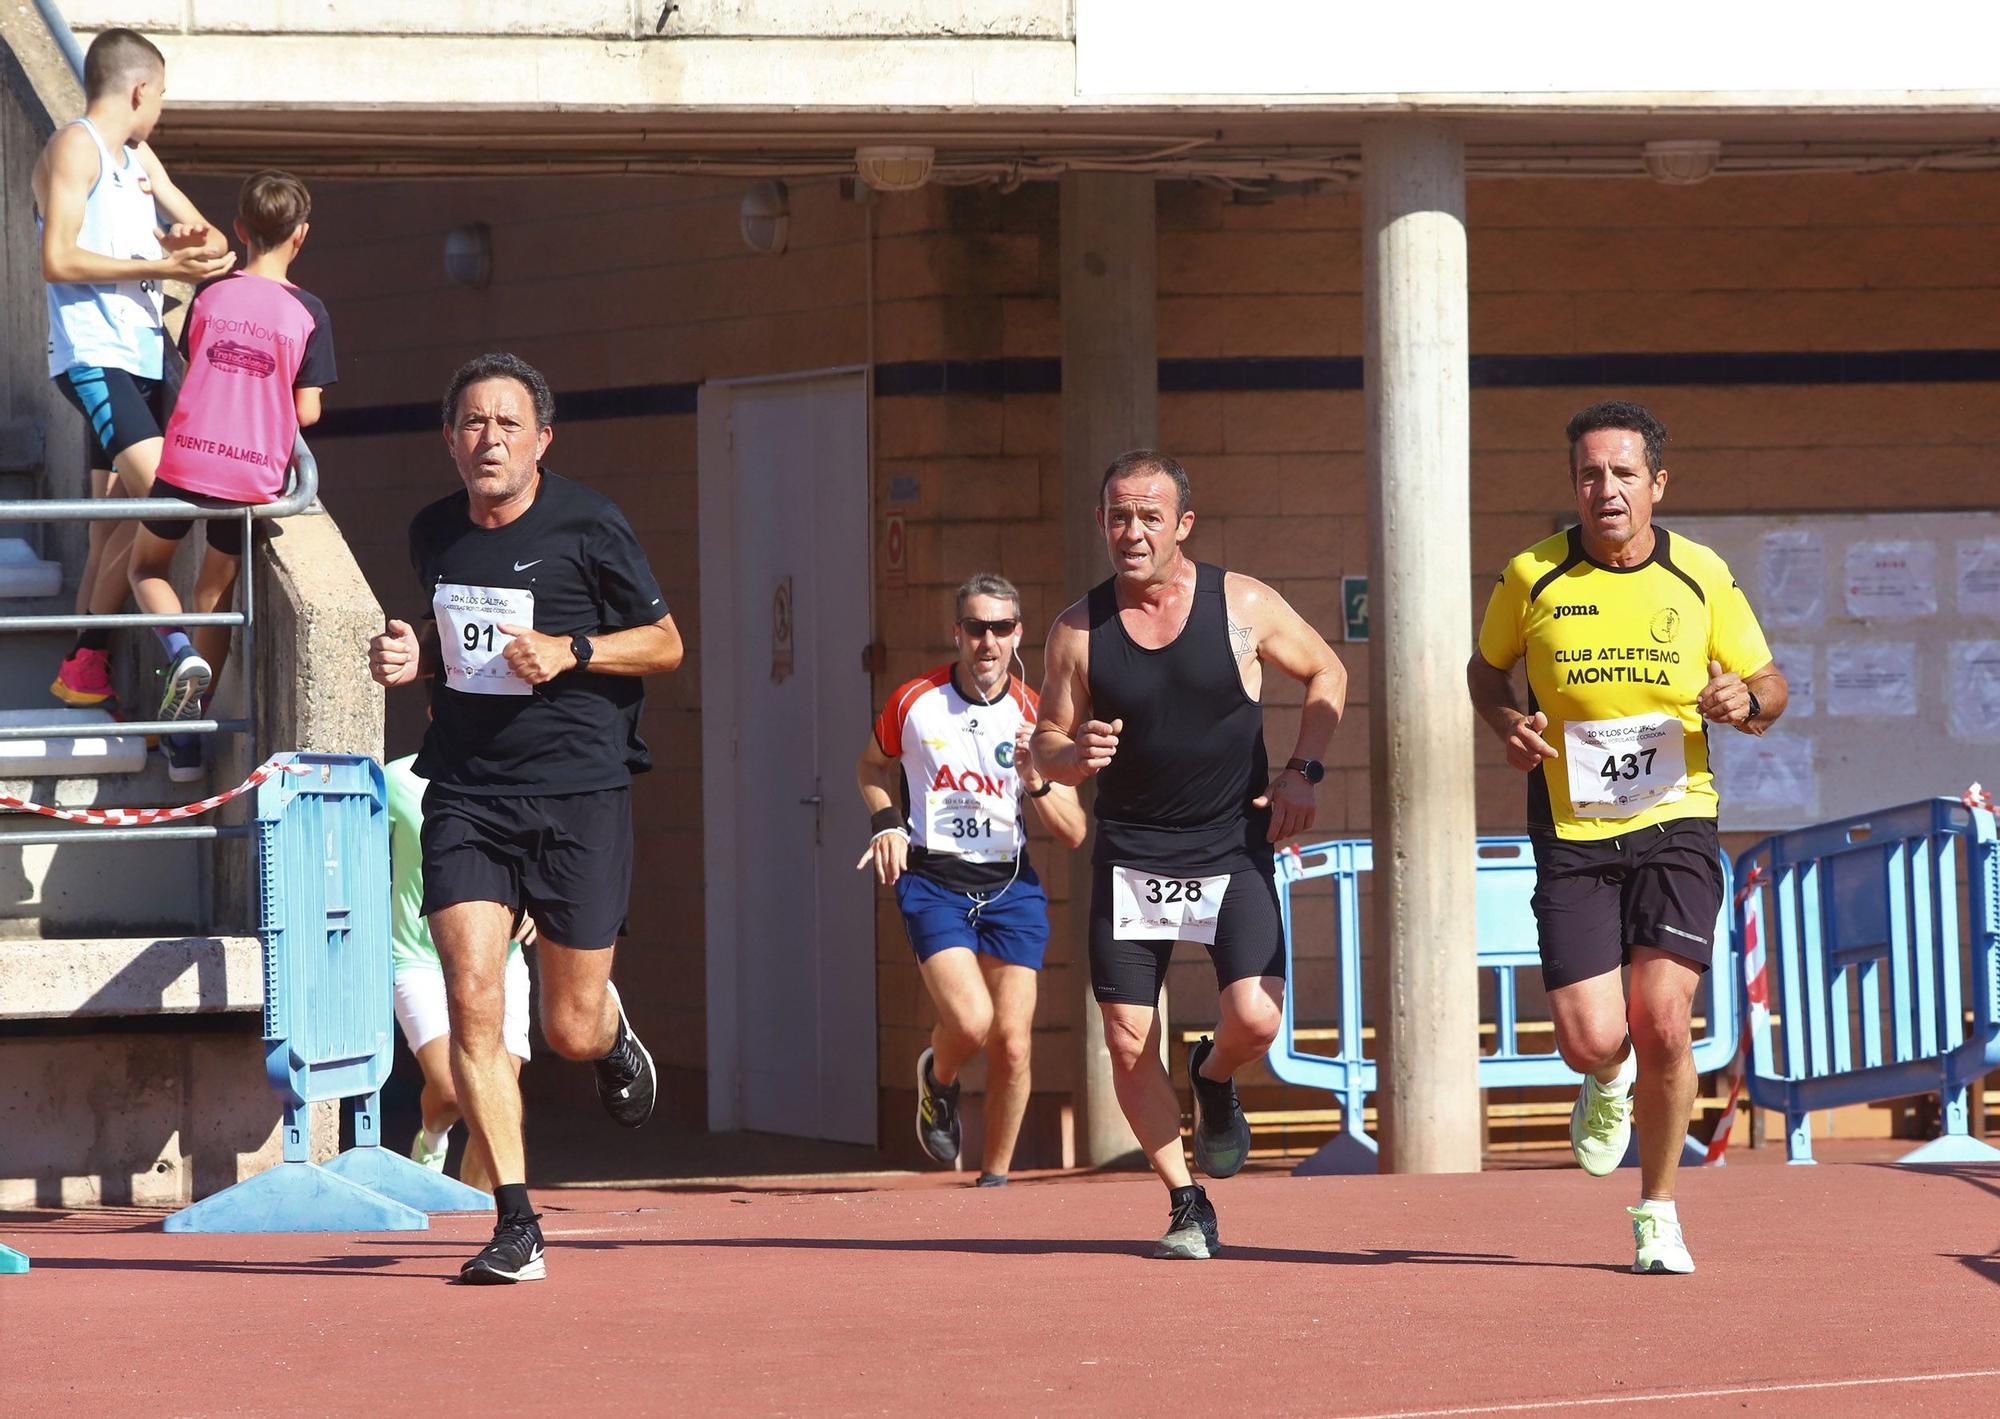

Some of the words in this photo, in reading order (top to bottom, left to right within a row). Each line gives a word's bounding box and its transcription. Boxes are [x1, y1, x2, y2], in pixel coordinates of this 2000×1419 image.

[175, 434, 216, 454] FUENTE
[217, 443, 269, 467] PALMERA
[463, 622, 494, 652] 91
[1554, 648, 1592, 662] CLUB
[1597, 647, 1680, 664] ATLETISMO
[1566, 666, 1671, 686] MONTILLA
[1605, 729, 1621, 737] LOS
[1600, 747, 1657, 782] 437
[932, 764, 1004, 799] AON
[952, 817, 991, 838] 381
[1145, 878, 1202, 904] 328
